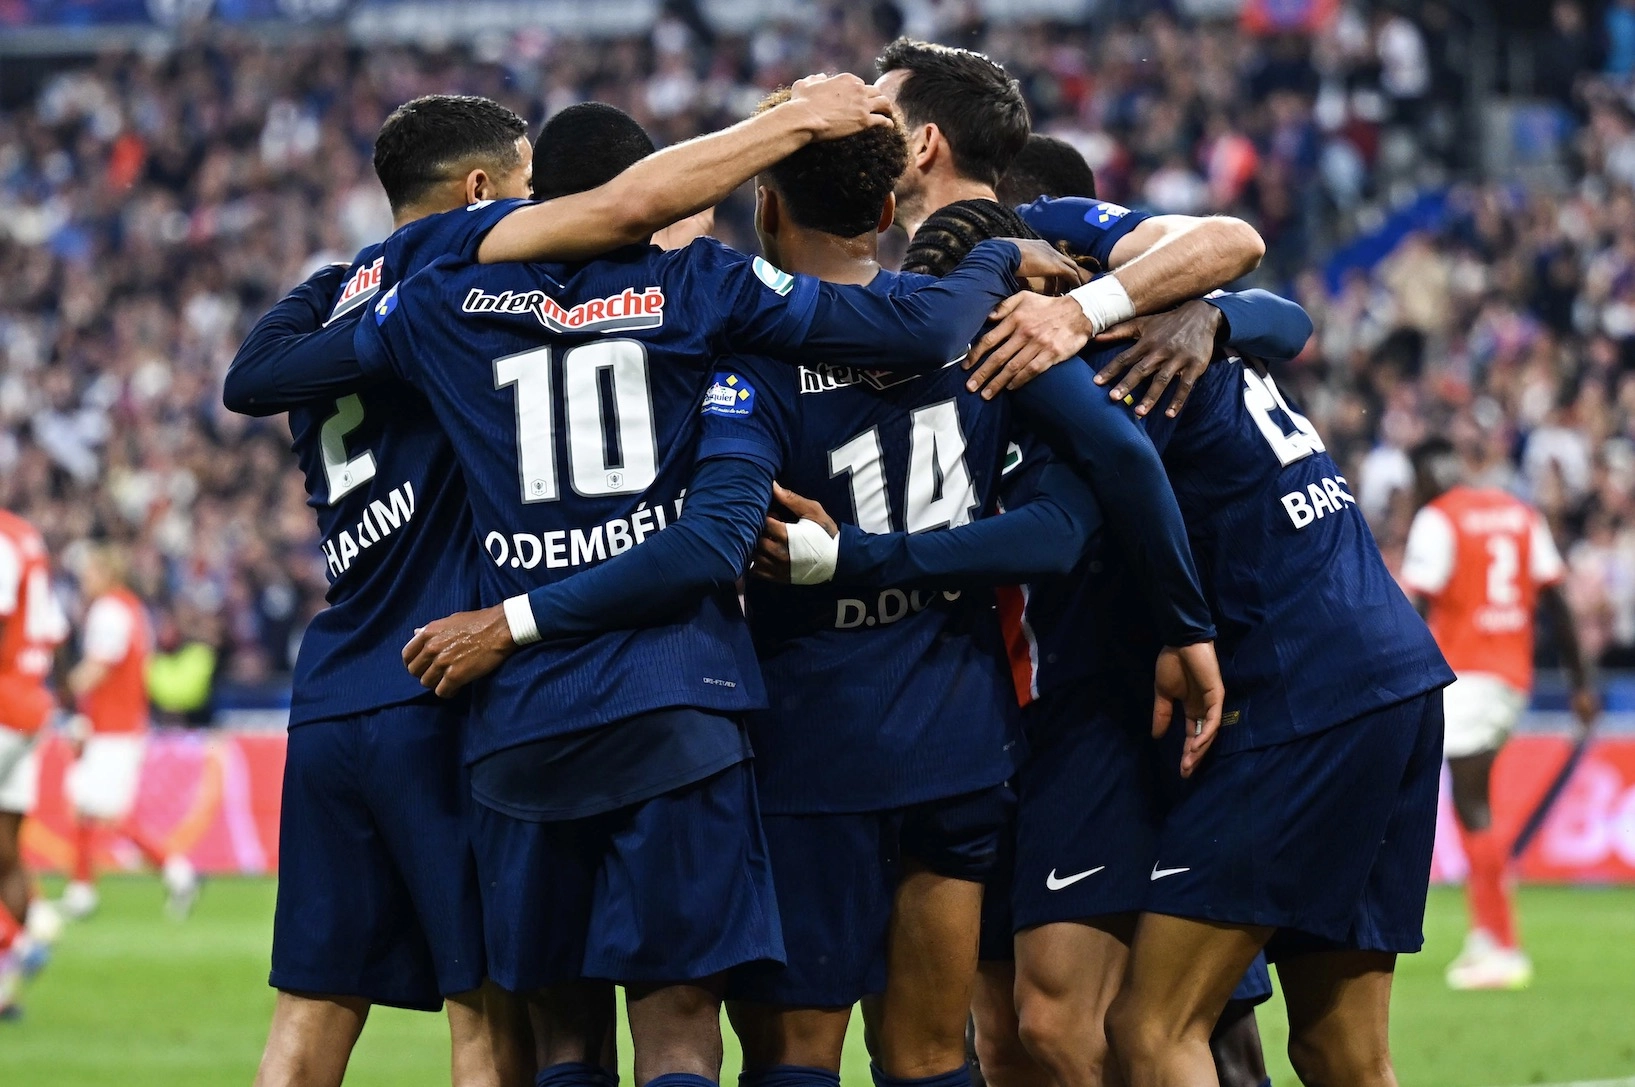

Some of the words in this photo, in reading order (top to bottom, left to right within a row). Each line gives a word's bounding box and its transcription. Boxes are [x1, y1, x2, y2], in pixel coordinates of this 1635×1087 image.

[319, 393, 377, 506] 2
[492, 338, 660, 504] 10
[827, 396, 980, 534] 14
